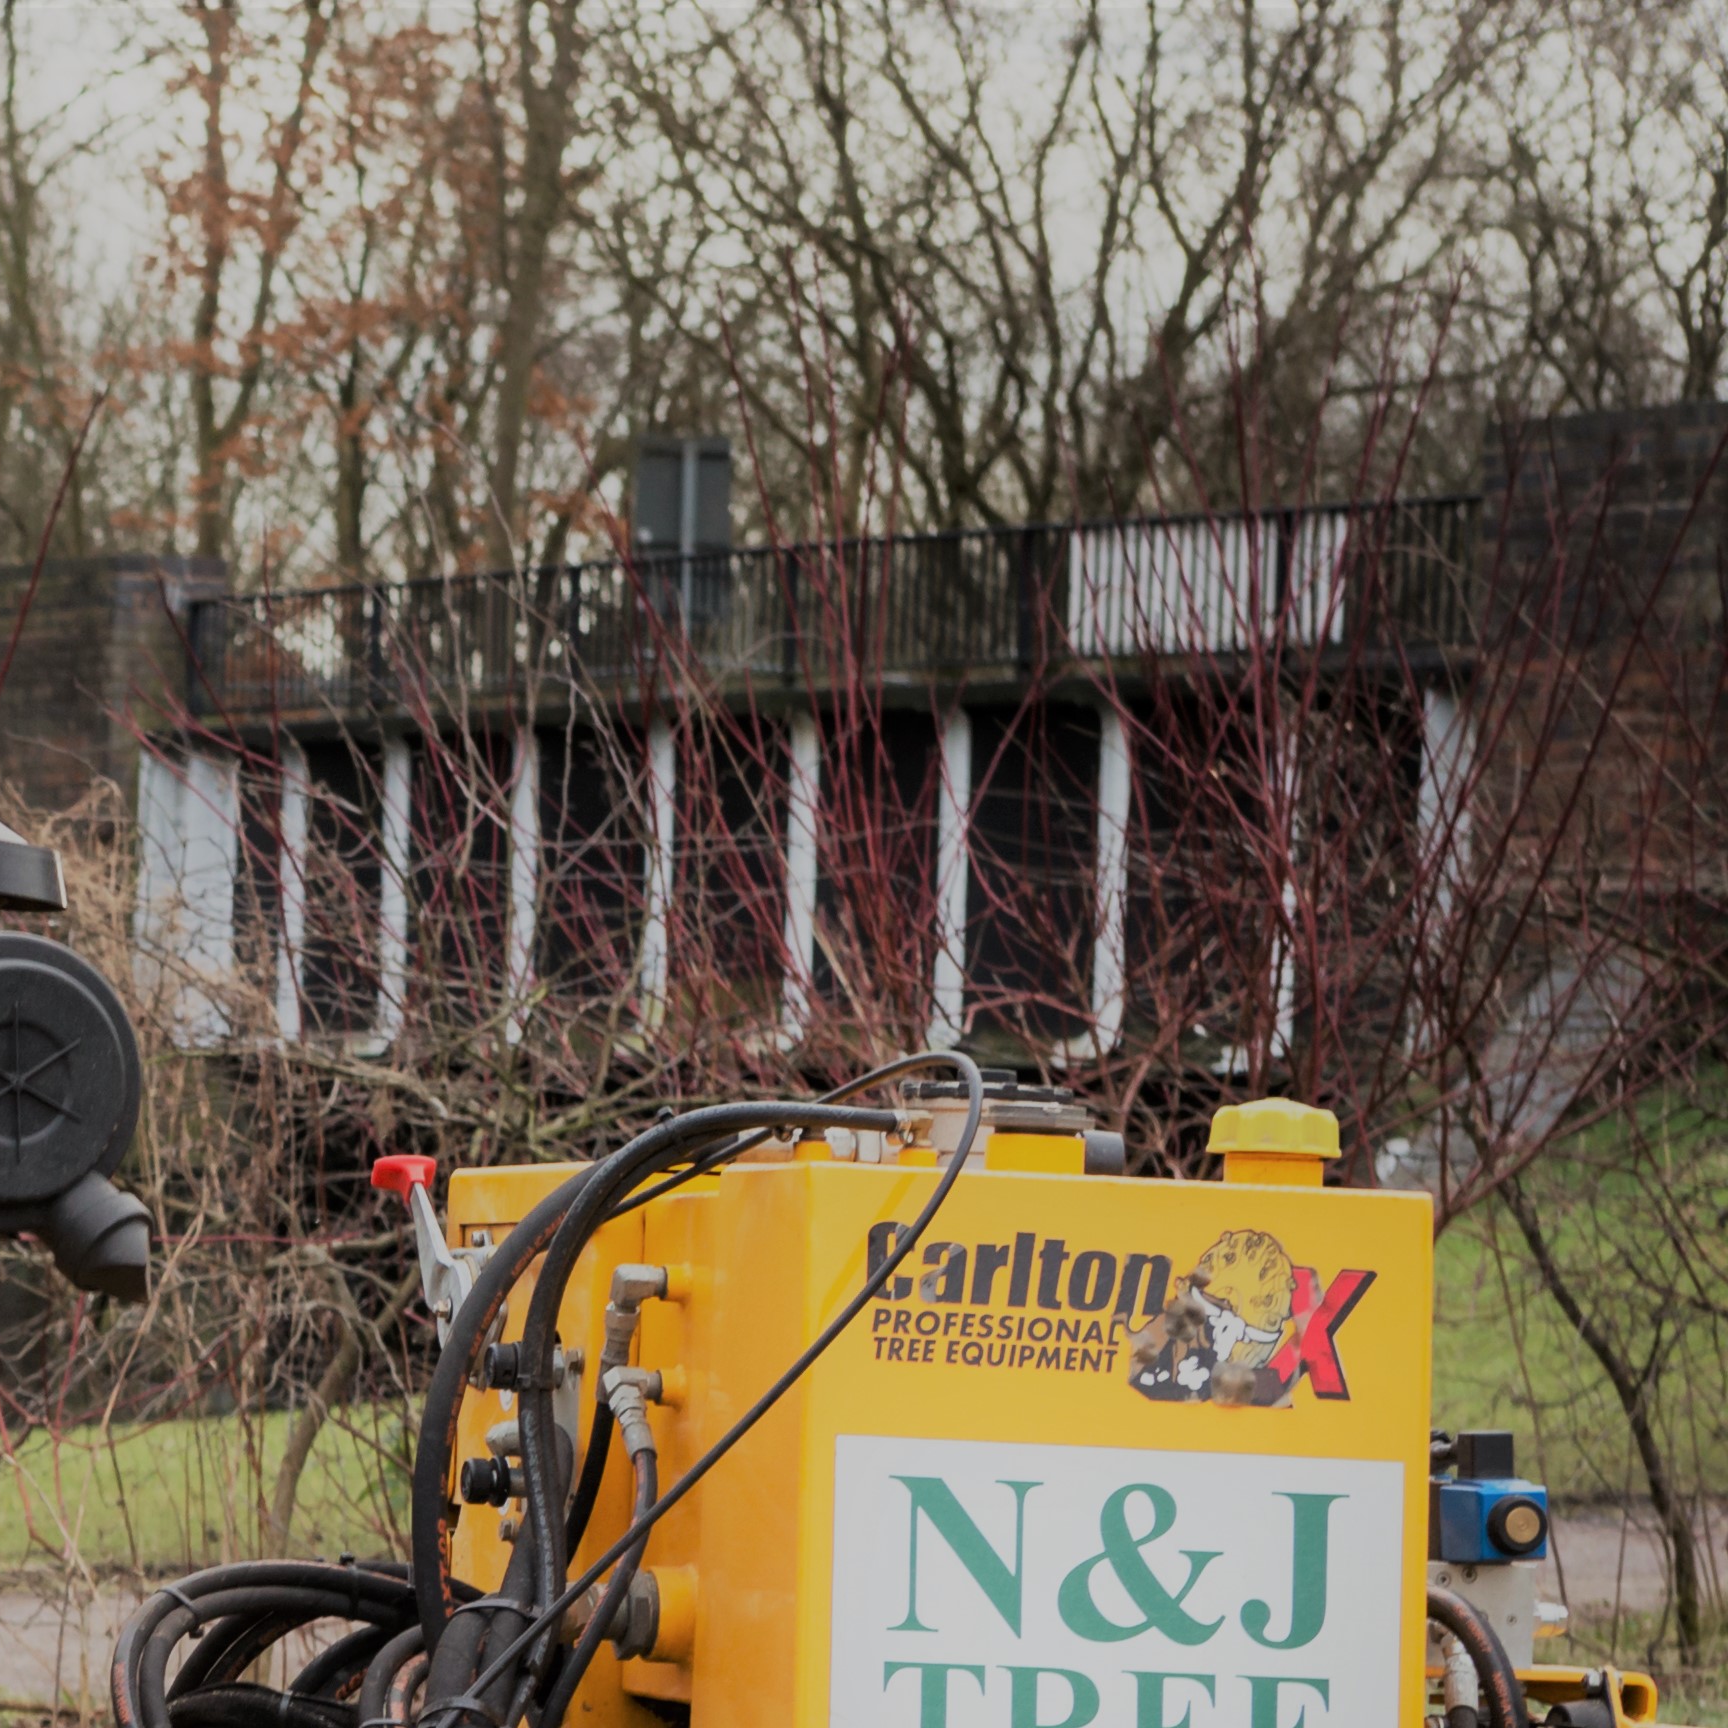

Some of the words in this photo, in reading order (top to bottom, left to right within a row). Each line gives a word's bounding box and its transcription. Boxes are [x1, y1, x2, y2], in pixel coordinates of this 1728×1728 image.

[867, 1221, 1172, 1317] Carlton
[872, 1309, 1124, 1346] PROFESSIONAL
[873, 1337, 937, 1363] TREE
[945, 1341, 1118, 1373] EQUIPMENT
[886, 1475, 1351, 1650] N&J
